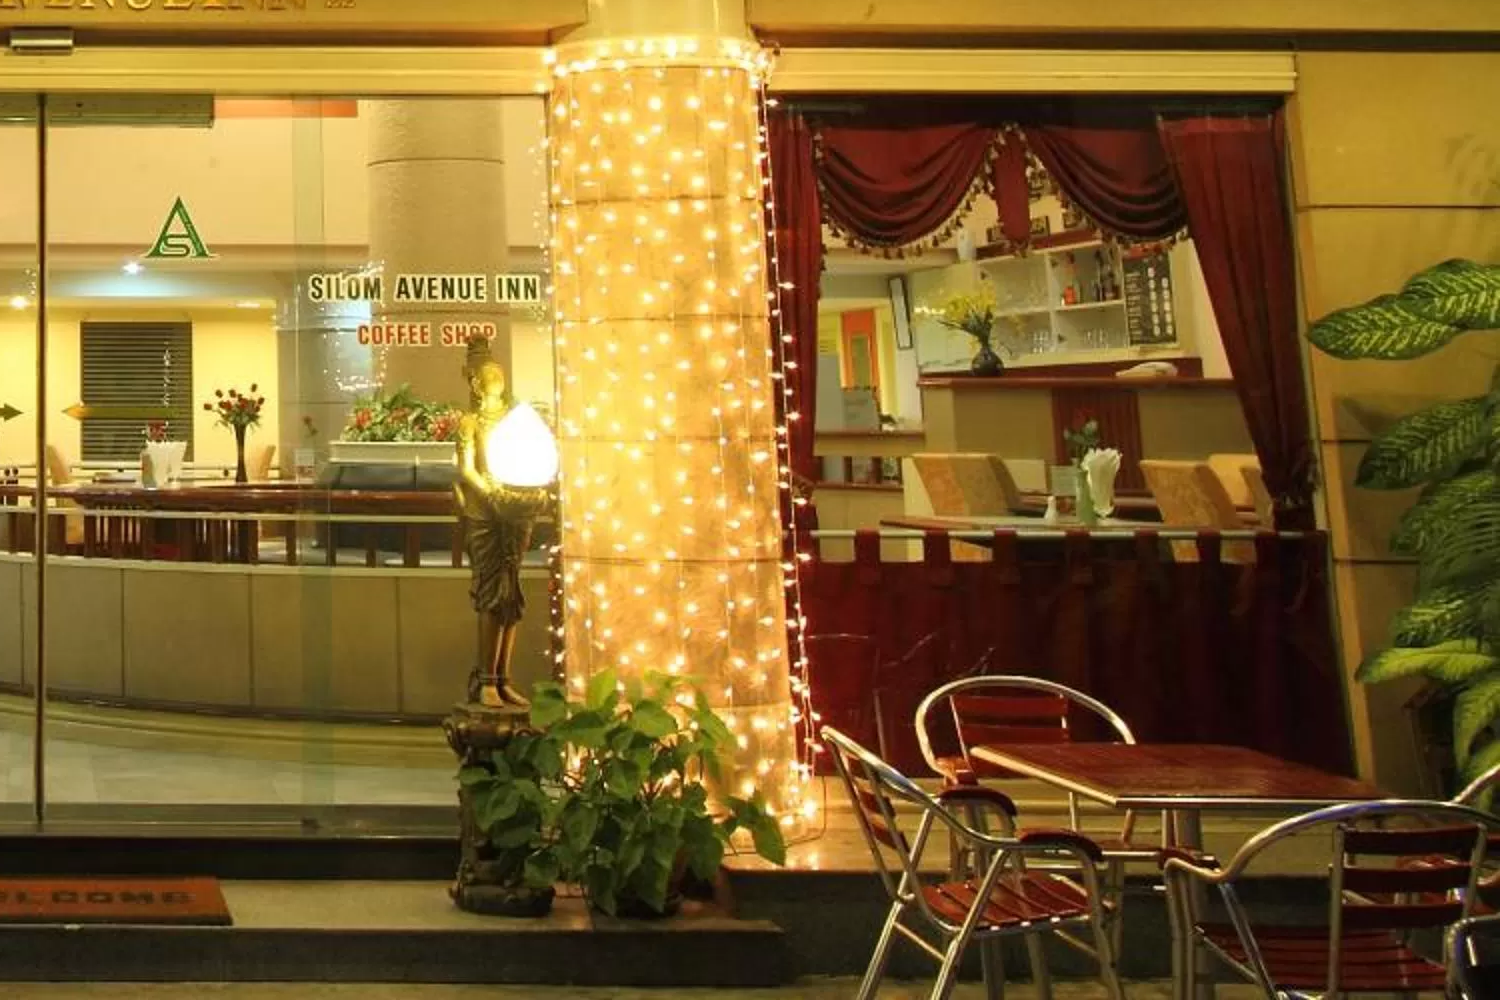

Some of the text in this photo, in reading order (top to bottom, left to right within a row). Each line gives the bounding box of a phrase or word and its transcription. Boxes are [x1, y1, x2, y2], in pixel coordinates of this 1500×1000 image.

[309, 275, 539, 301] SILOM AVENUE INN
[357, 323, 430, 346] COFFEE
